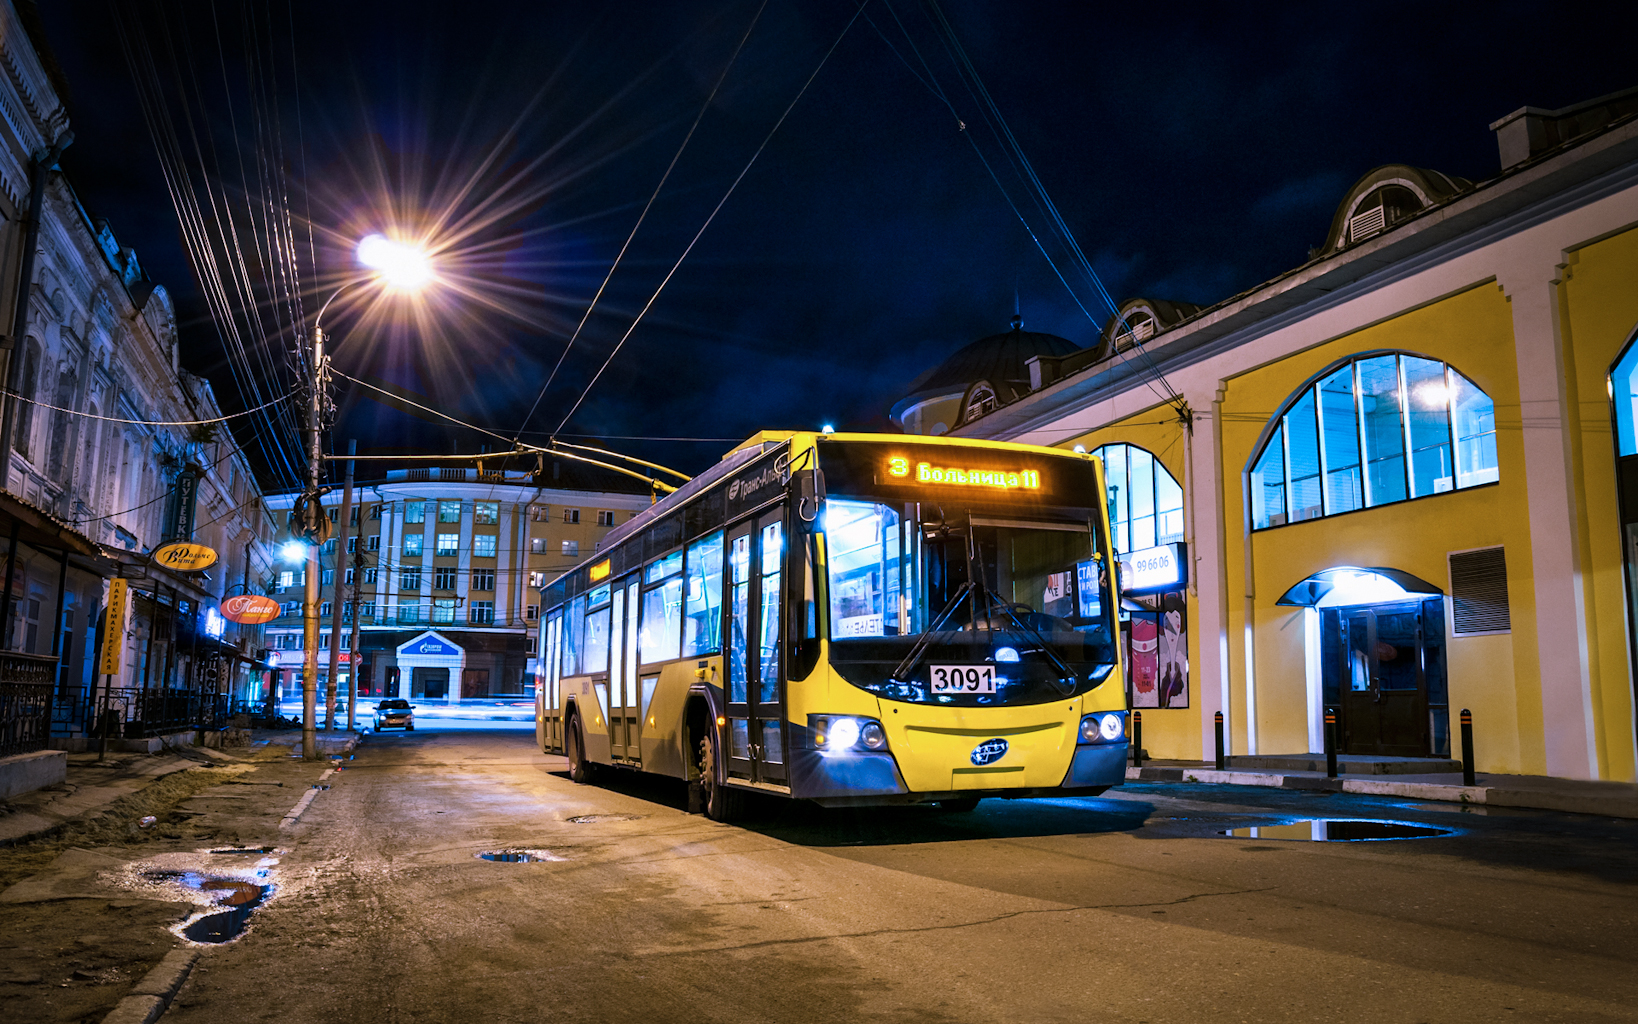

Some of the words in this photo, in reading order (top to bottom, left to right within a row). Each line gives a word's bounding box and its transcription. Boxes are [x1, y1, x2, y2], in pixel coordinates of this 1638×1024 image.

[890, 457, 909, 476] 3
[918, 463, 1018, 488] Больница
[1021, 470, 1039, 488] 11
[1137, 560, 1147, 572] 99
[1148, 558, 1158, 570] 66
[1159, 555, 1169, 568] 06
[106, 581, 120, 671] ПАРИКМАХЕРСКАЯ
[934, 668, 993, 691] 3091
